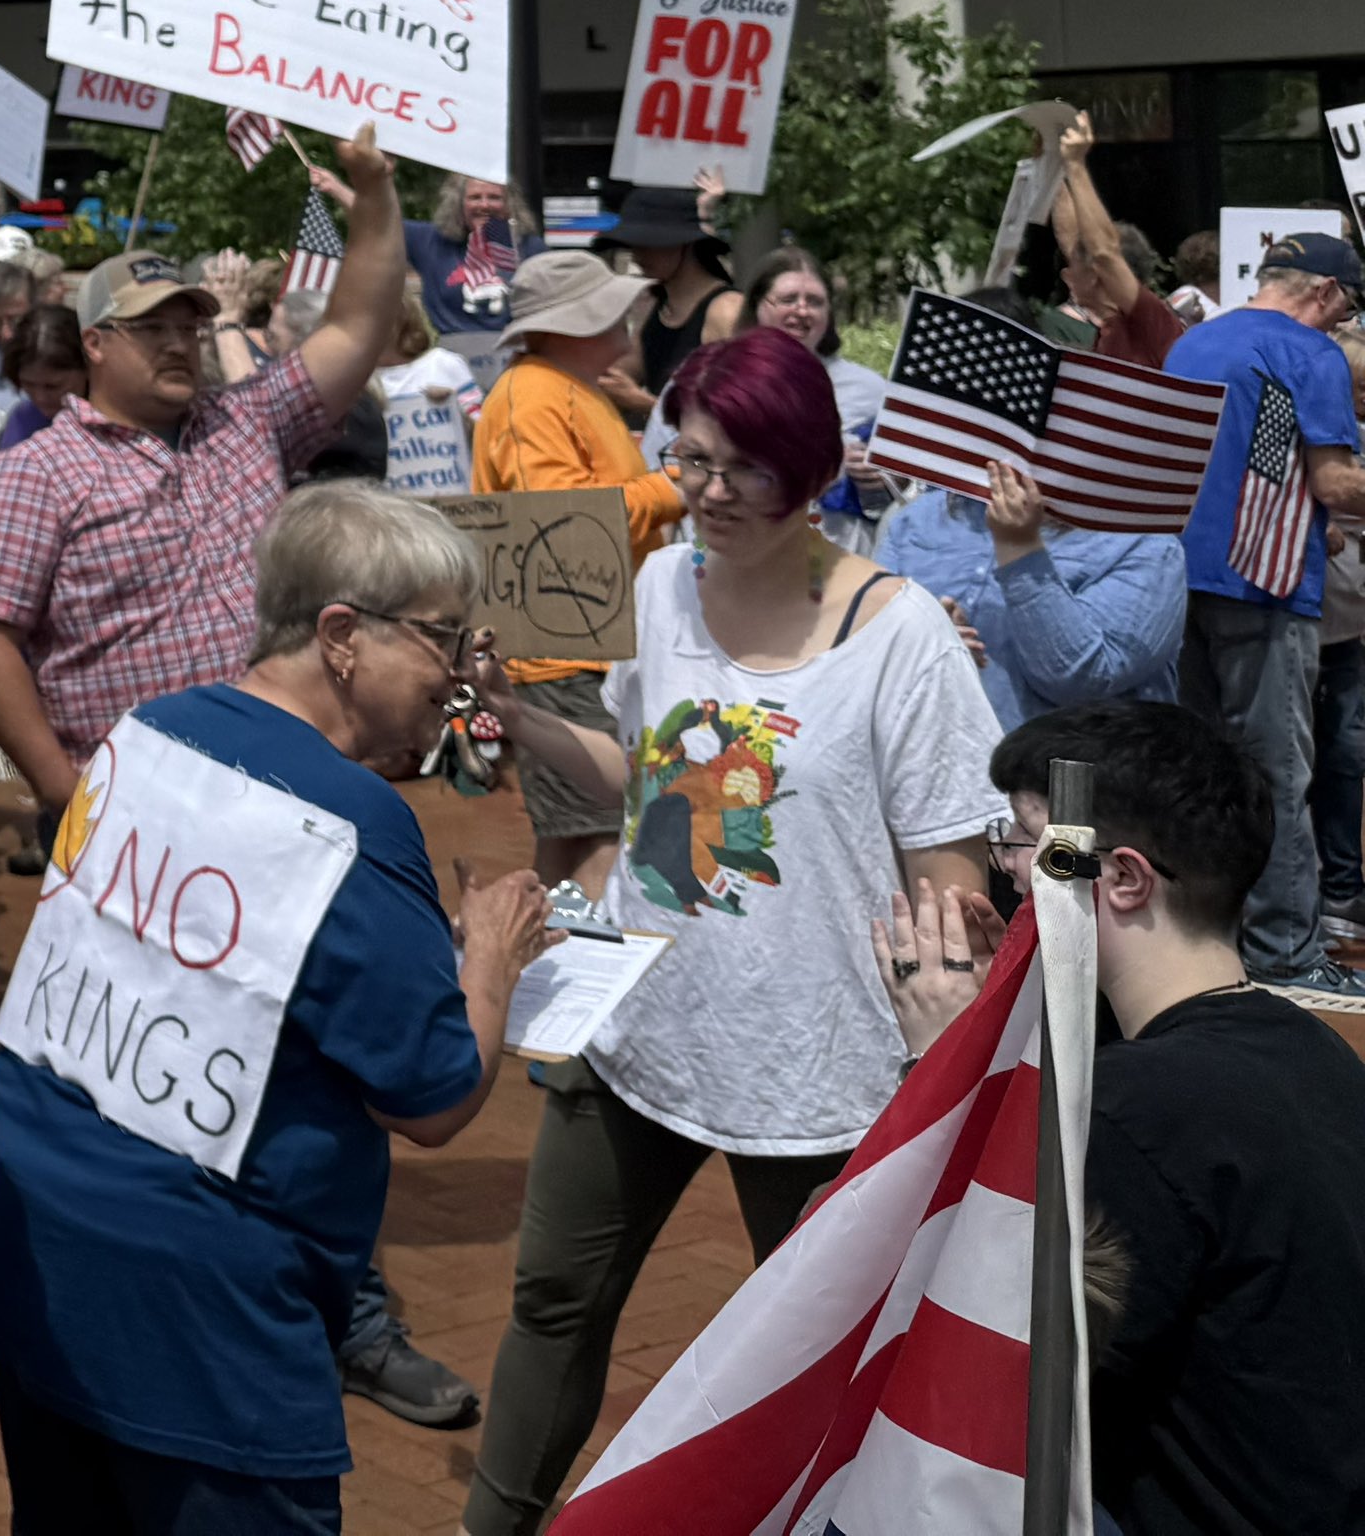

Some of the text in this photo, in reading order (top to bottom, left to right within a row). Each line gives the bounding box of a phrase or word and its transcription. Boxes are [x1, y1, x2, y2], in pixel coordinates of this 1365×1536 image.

[77, 68, 156, 111] KING
[208, 11, 458, 134] BALANCES
[644, 15, 773, 89] FOR
[636, 79, 751, 148] ALL
[96, 827, 242, 971] NO
[24, 942, 246, 1138] KINGS
